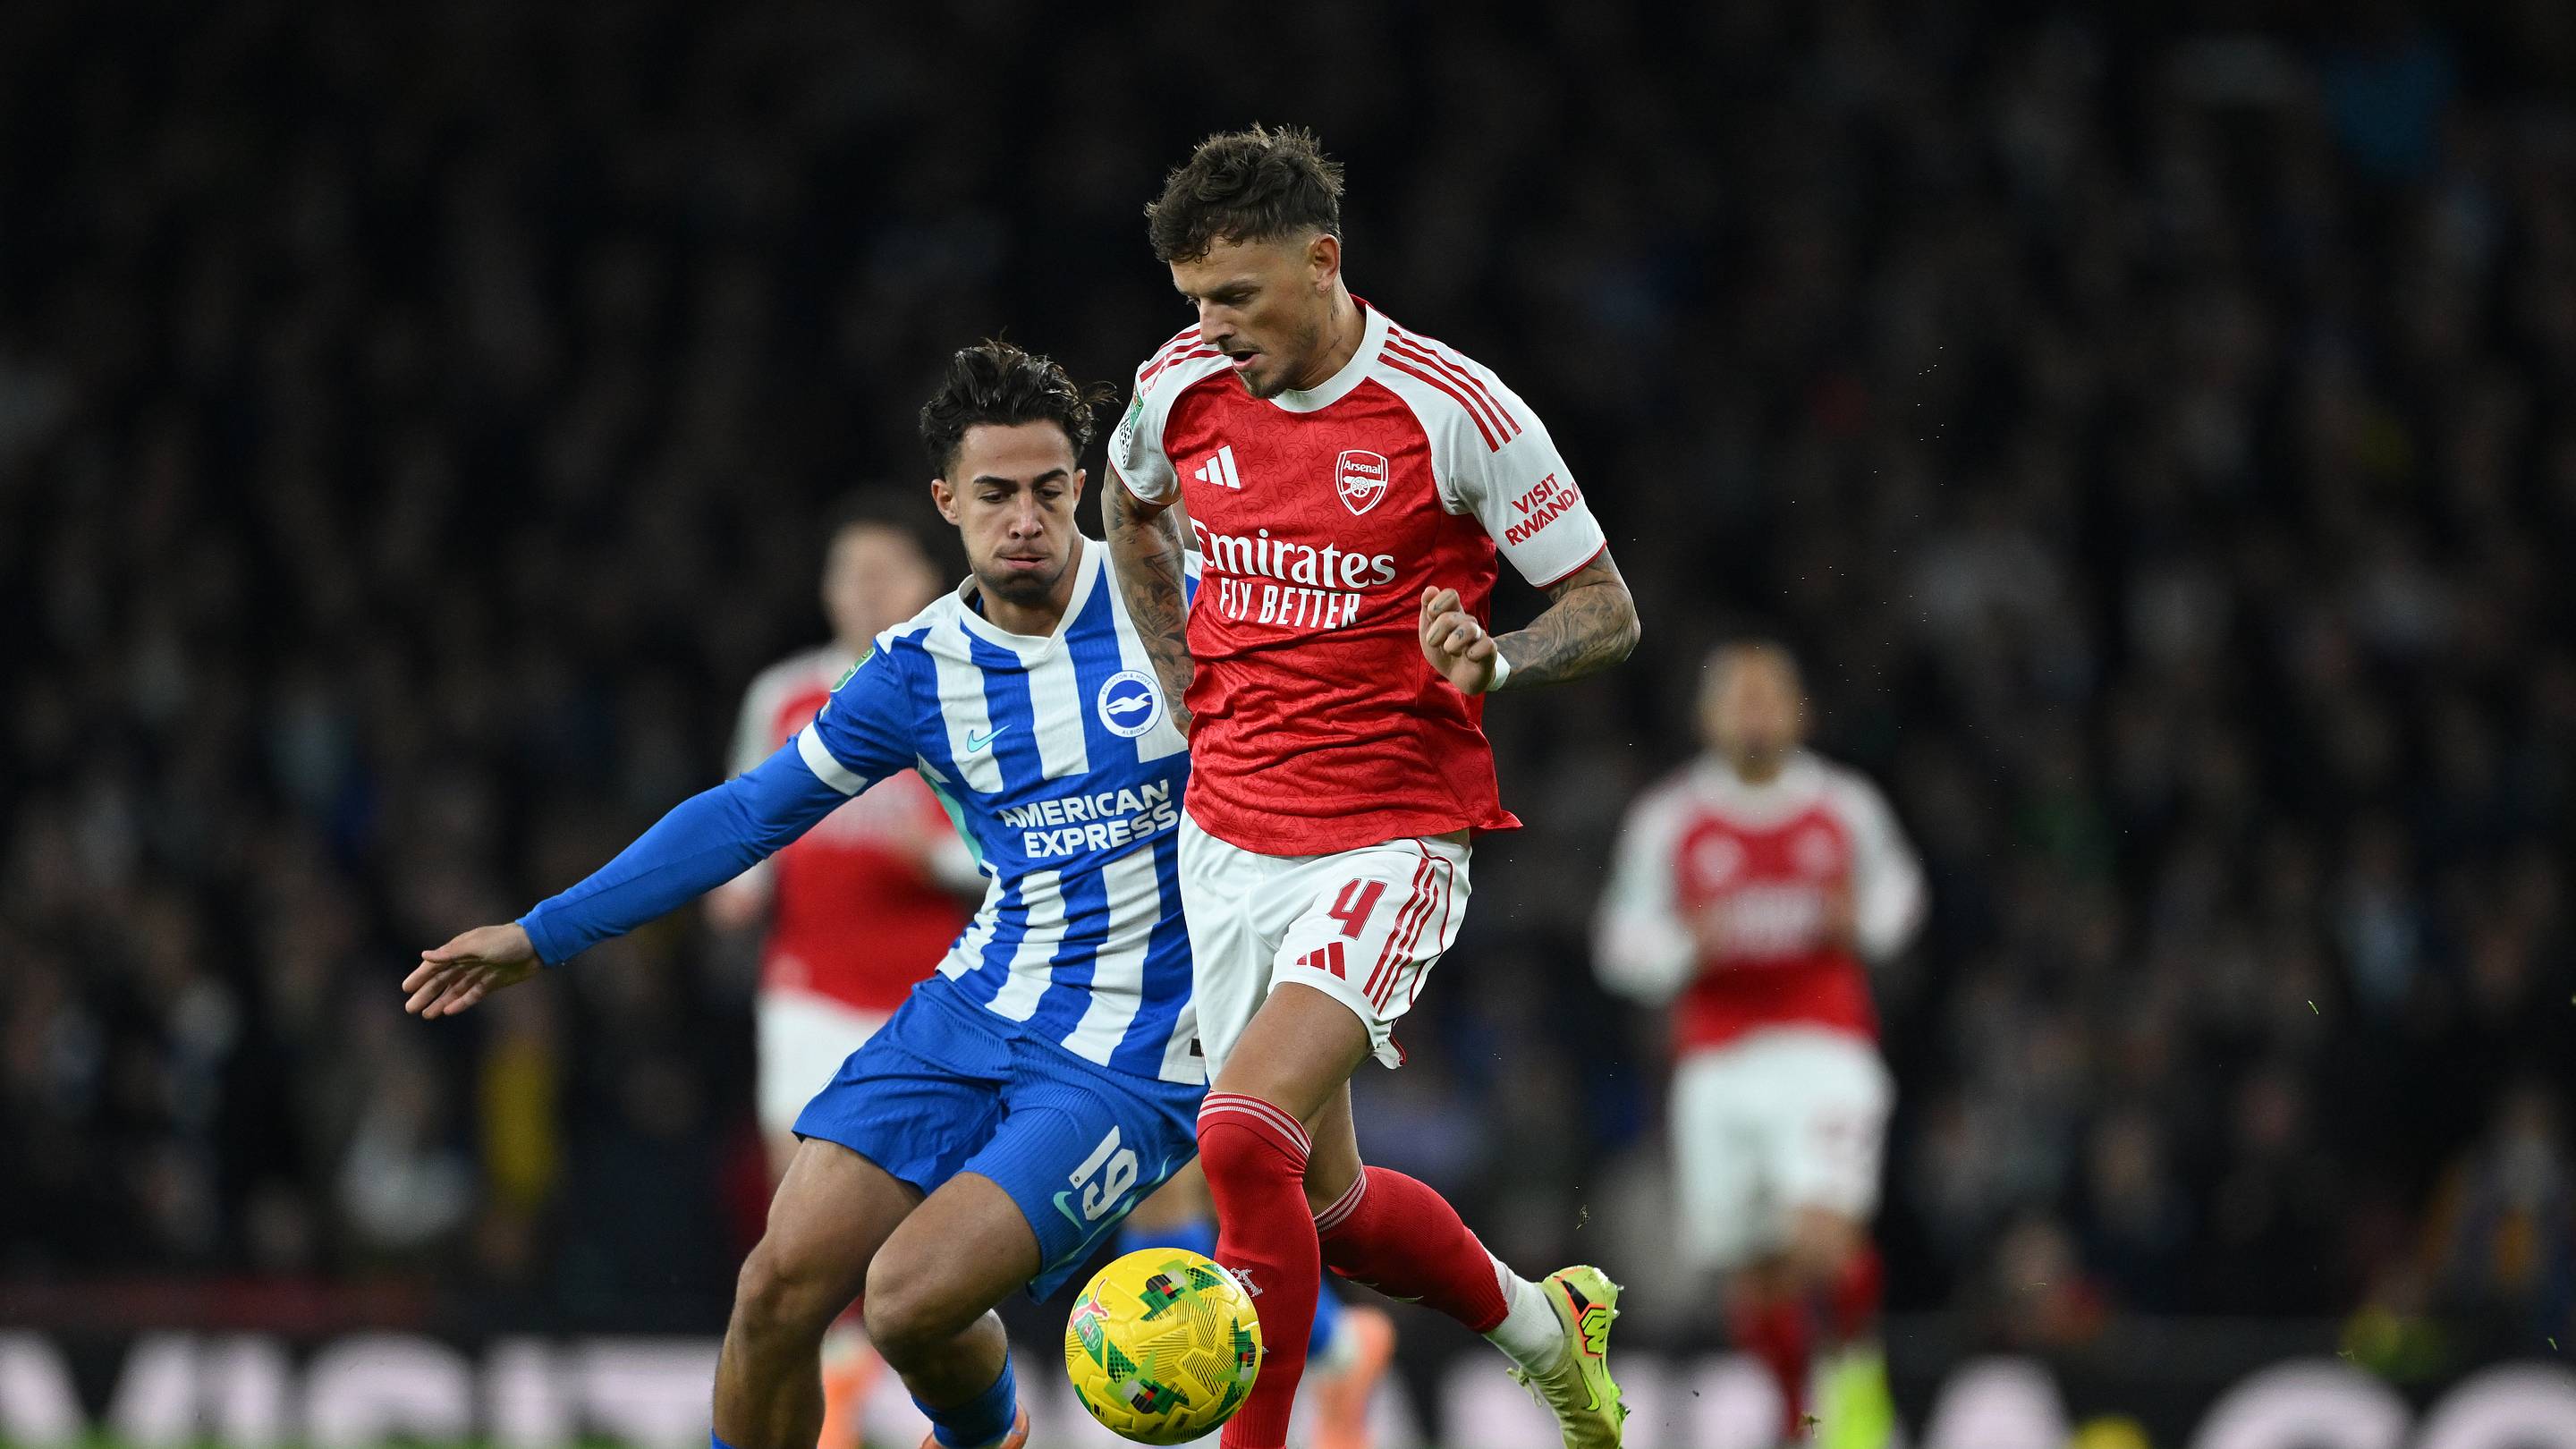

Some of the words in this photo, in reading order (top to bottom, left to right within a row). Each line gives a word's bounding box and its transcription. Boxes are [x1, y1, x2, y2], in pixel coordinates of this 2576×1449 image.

[1343, 461, 1381, 474] Arsenal
[1511, 472, 1560, 514] VISIT
[1189, 515, 1395, 589] Emirates
[1219, 577, 1252, 621] FLY
[1258, 585, 1361, 630] BETTER
[1101, 674, 1128, 695] BRIGHTON
[1136, 674, 1152, 686] HOVE
[1122, 726, 1146, 735] ALBION
[998, 779, 1169, 828] AMERICAN
[1023, 801, 1178, 859] EXPRESS
[1326, 878, 1387, 941] 4
[1069, 1125, 1138, 1221] 19
